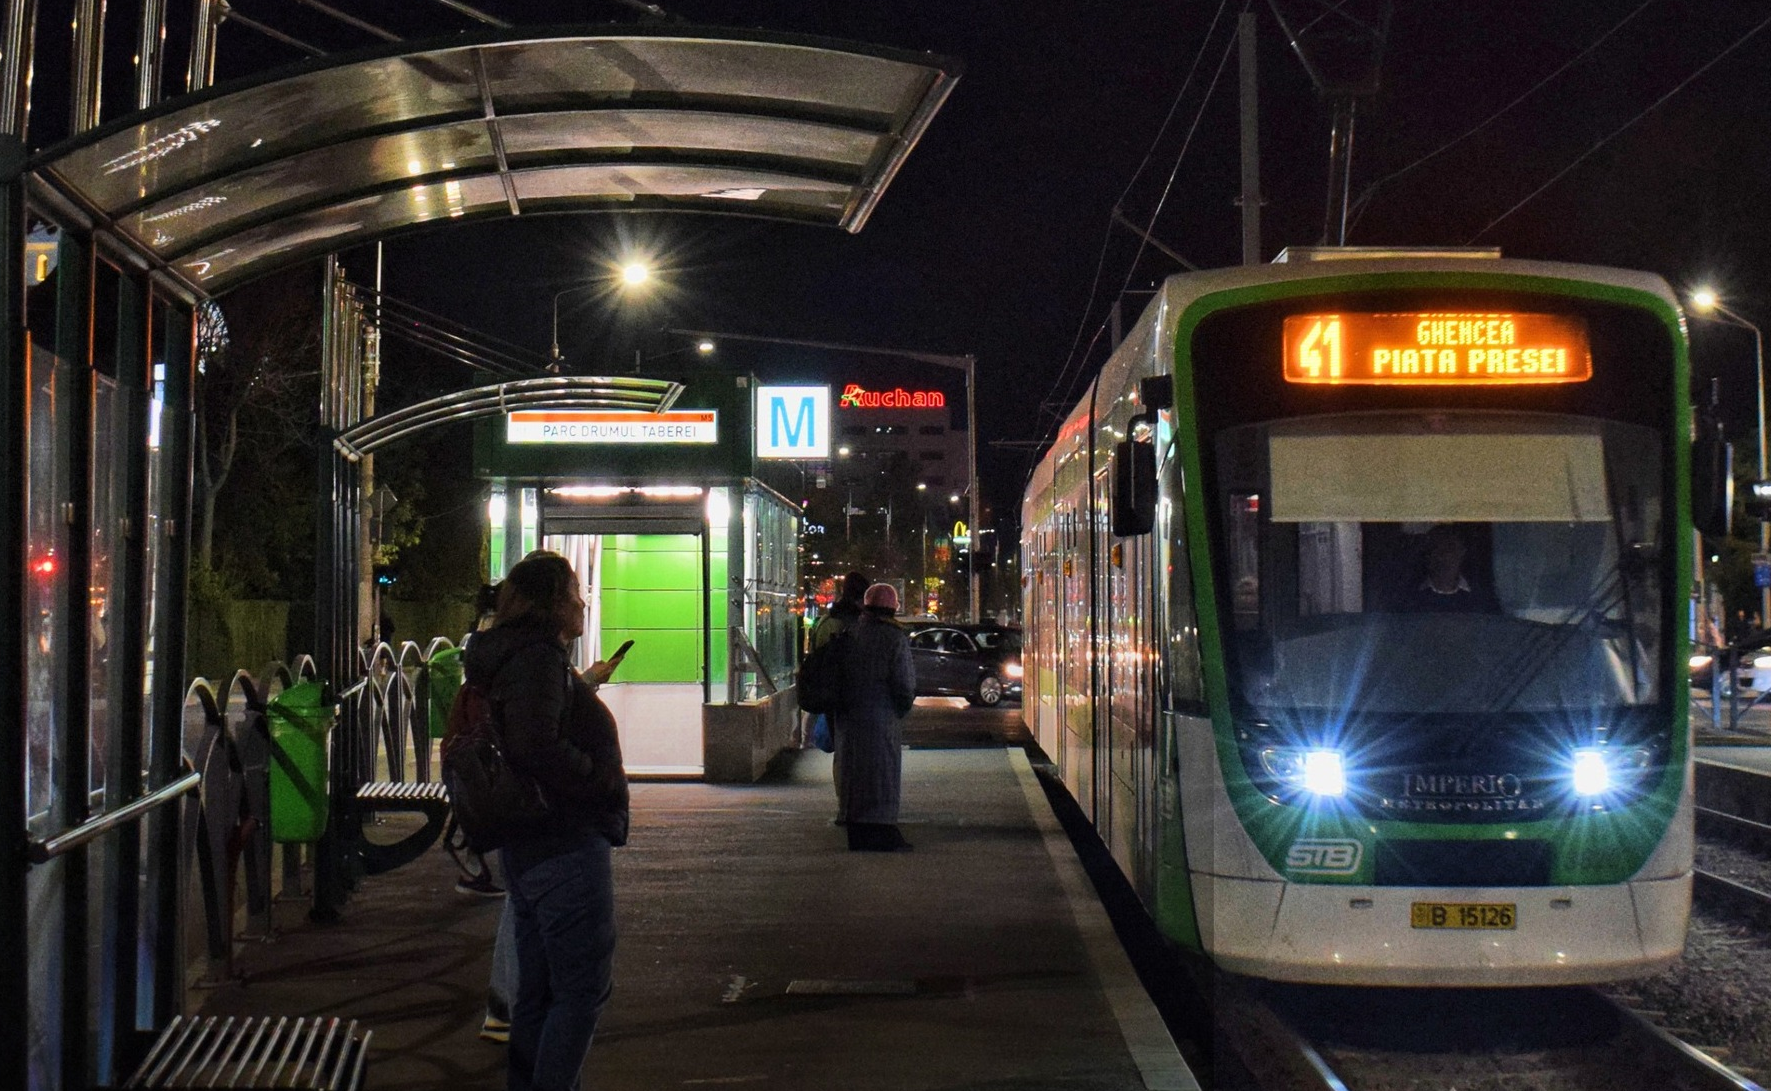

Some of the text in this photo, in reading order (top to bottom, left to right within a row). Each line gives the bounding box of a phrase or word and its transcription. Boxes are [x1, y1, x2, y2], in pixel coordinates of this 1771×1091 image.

[1299, 320, 1341, 378] 41
[1373, 348, 1566, 374] PIATA PRESEI
[840, 384, 945, 408] Auchan
[543, 425, 696, 438] PARC DRUMUL TABEREI
[771, 397, 815, 447] M
[1401, 773, 1521, 798] IMPERIO
[1286, 845, 1356, 868] STB
[1432, 906, 1447, 926] B
[1459, 906, 1512, 926] 15126
